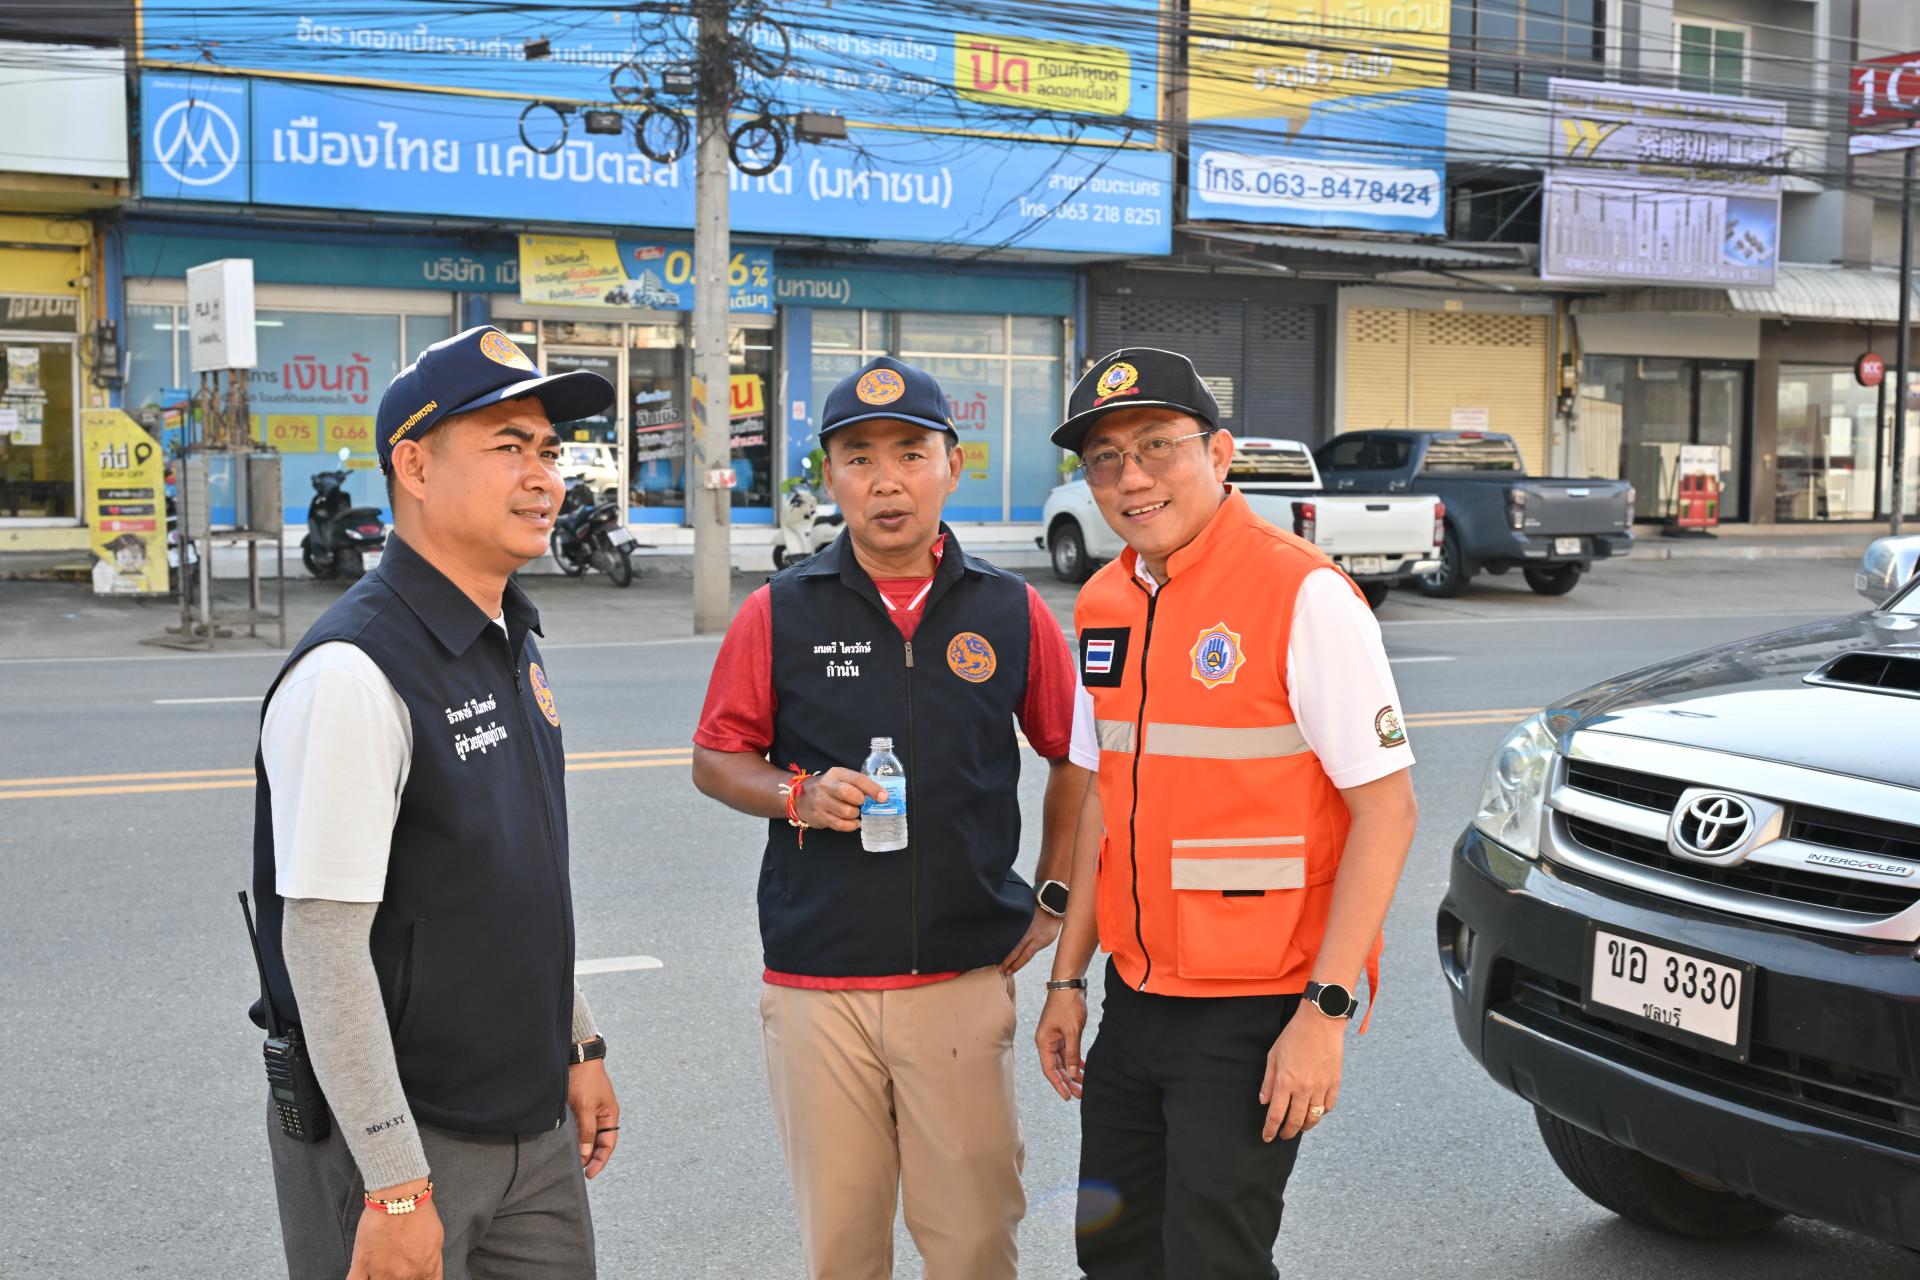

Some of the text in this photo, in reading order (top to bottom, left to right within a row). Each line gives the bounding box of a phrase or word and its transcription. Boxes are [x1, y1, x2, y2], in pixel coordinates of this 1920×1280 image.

[969, 41, 1029, 96] ปิด
[272, 115, 461, 173] เมืองไทย
[808, 157, 953, 209] (มหาชน)
[1091, 203, 1121, 224] 218
[1123, 206, 1162, 227] 8251
[423, 256, 485, 283] บริษัท
[773, 275, 851, 304] (มหาชน)
[664, 249, 749, 288] 0.6
[282, 352, 371, 404] เงินกู้
[274, 425, 368, 440] 0.75 0.66
[826, 659, 860, 678] กำนัน
[1807, 852, 1908, 875] INTERCOOLER
[1607, 939, 1737, 1011] ขอ 3330
